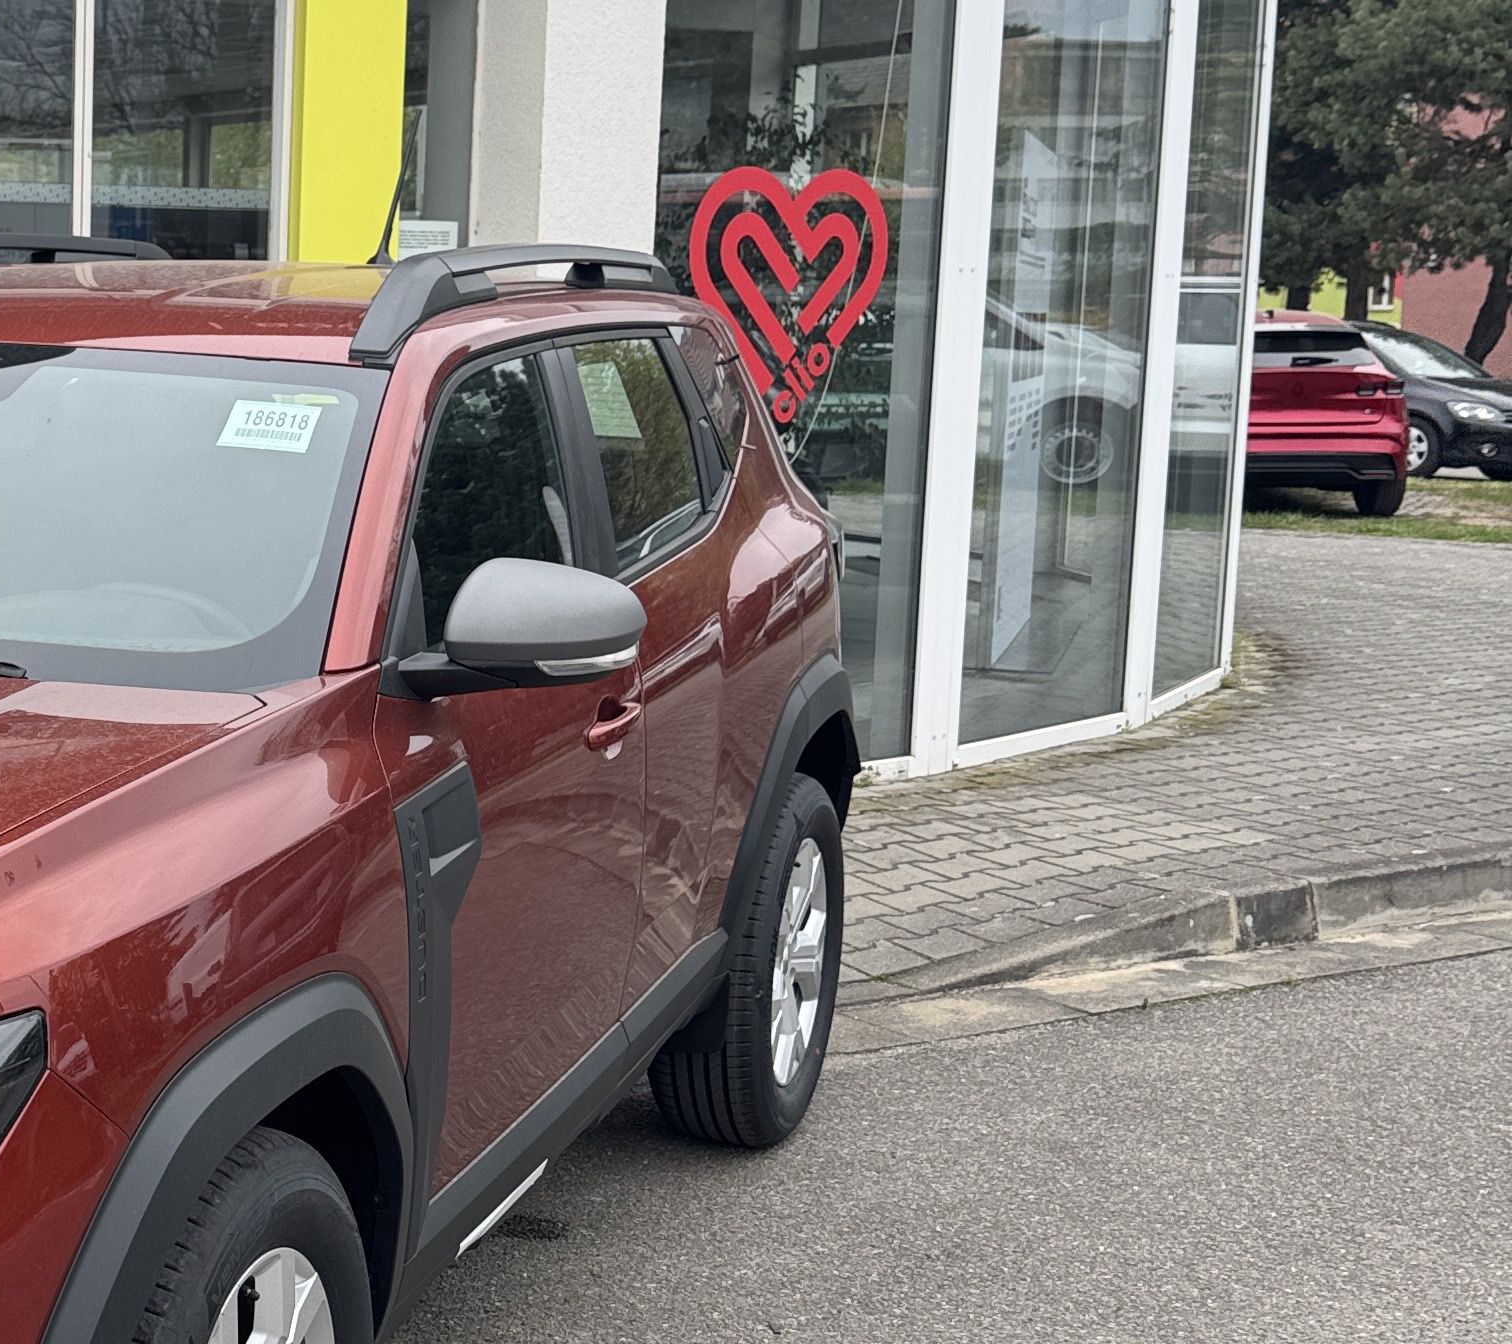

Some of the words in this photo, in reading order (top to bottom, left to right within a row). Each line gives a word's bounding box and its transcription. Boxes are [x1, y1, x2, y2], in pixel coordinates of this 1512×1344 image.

[244, 410, 311, 431] 186818
[773, 343, 831, 424] clio
[408, 816, 427, 1003] DUSTER
